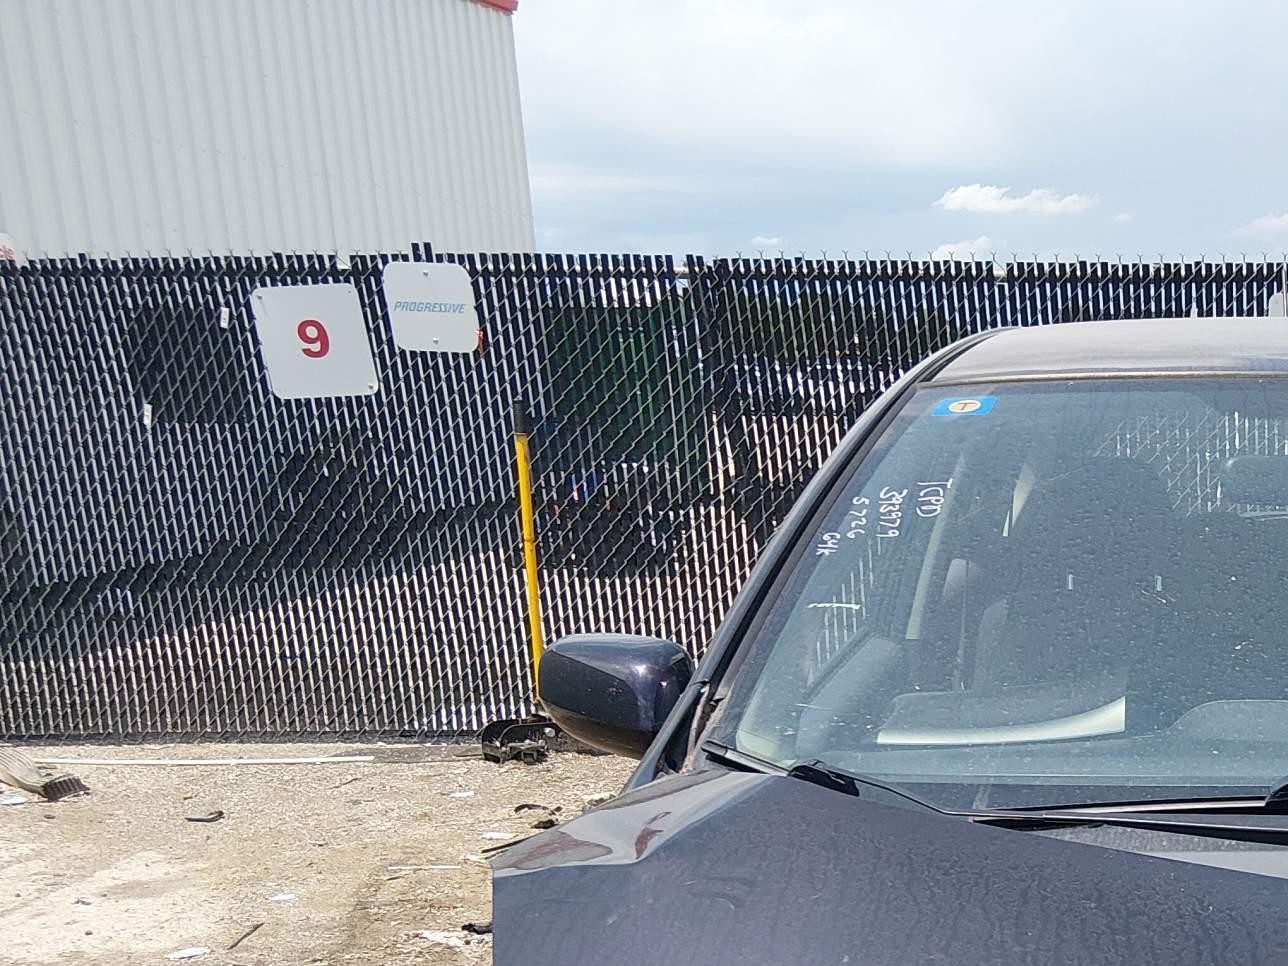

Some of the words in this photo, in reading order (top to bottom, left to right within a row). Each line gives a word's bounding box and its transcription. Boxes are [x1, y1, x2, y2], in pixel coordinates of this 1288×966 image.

[394, 301, 466, 314] PROGRESSIVE
[297, 319, 330, 358] 9
[876, 486, 908, 538] 393979
